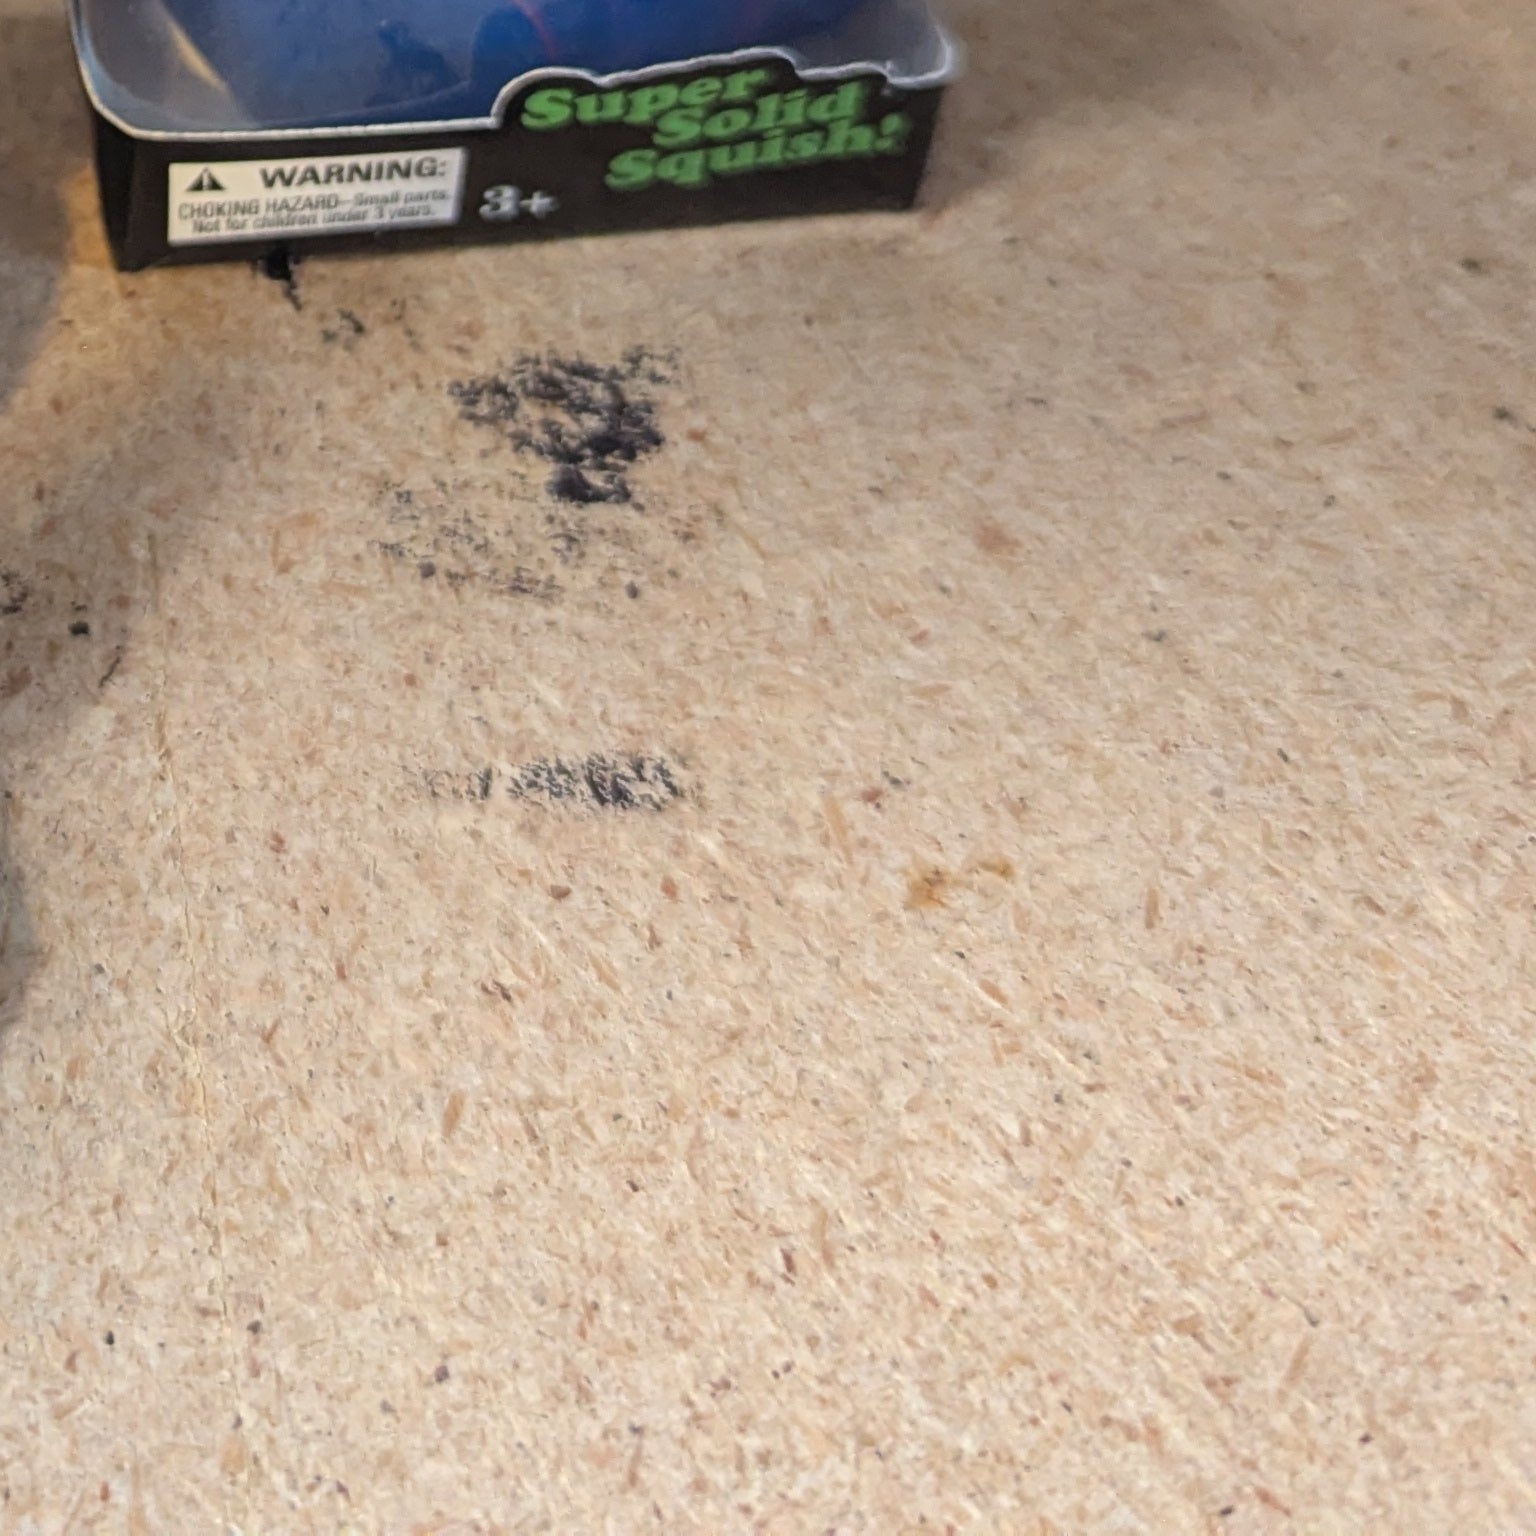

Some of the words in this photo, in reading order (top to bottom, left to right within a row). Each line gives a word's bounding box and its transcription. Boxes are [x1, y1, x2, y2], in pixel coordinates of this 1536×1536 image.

[520, 68, 771, 130] Super
[653, 81, 865, 147] Solid
[605, 113, 910, 190] Squish!
[260, 157, 447, 188] WARNING:
[178, 199, 259, 220] CHOKING
[479, 184, 559, 221] 3+
[193, 219, 221, 234] Not
[226, 217, 247, 231] for
[253, 213, 317, 230] children
